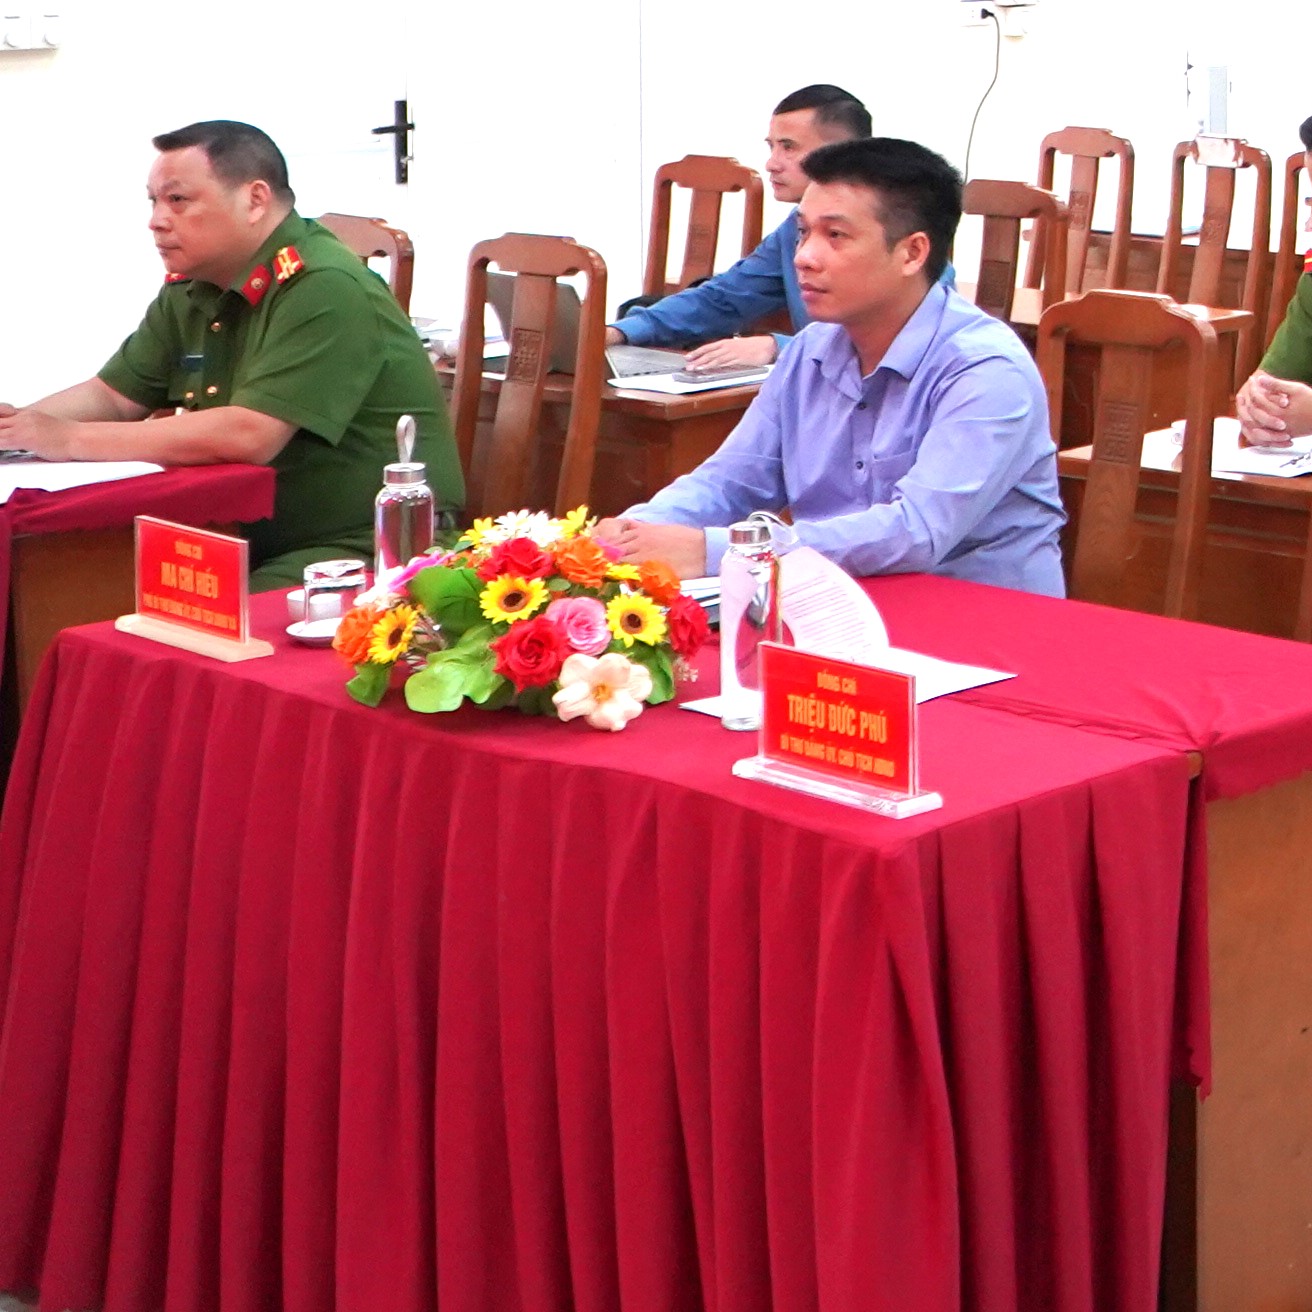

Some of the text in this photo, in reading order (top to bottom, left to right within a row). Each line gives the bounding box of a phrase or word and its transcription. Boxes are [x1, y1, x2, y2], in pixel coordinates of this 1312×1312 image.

[787, 692, 888, 744] TRIỆU ĐỨC PHÚ
